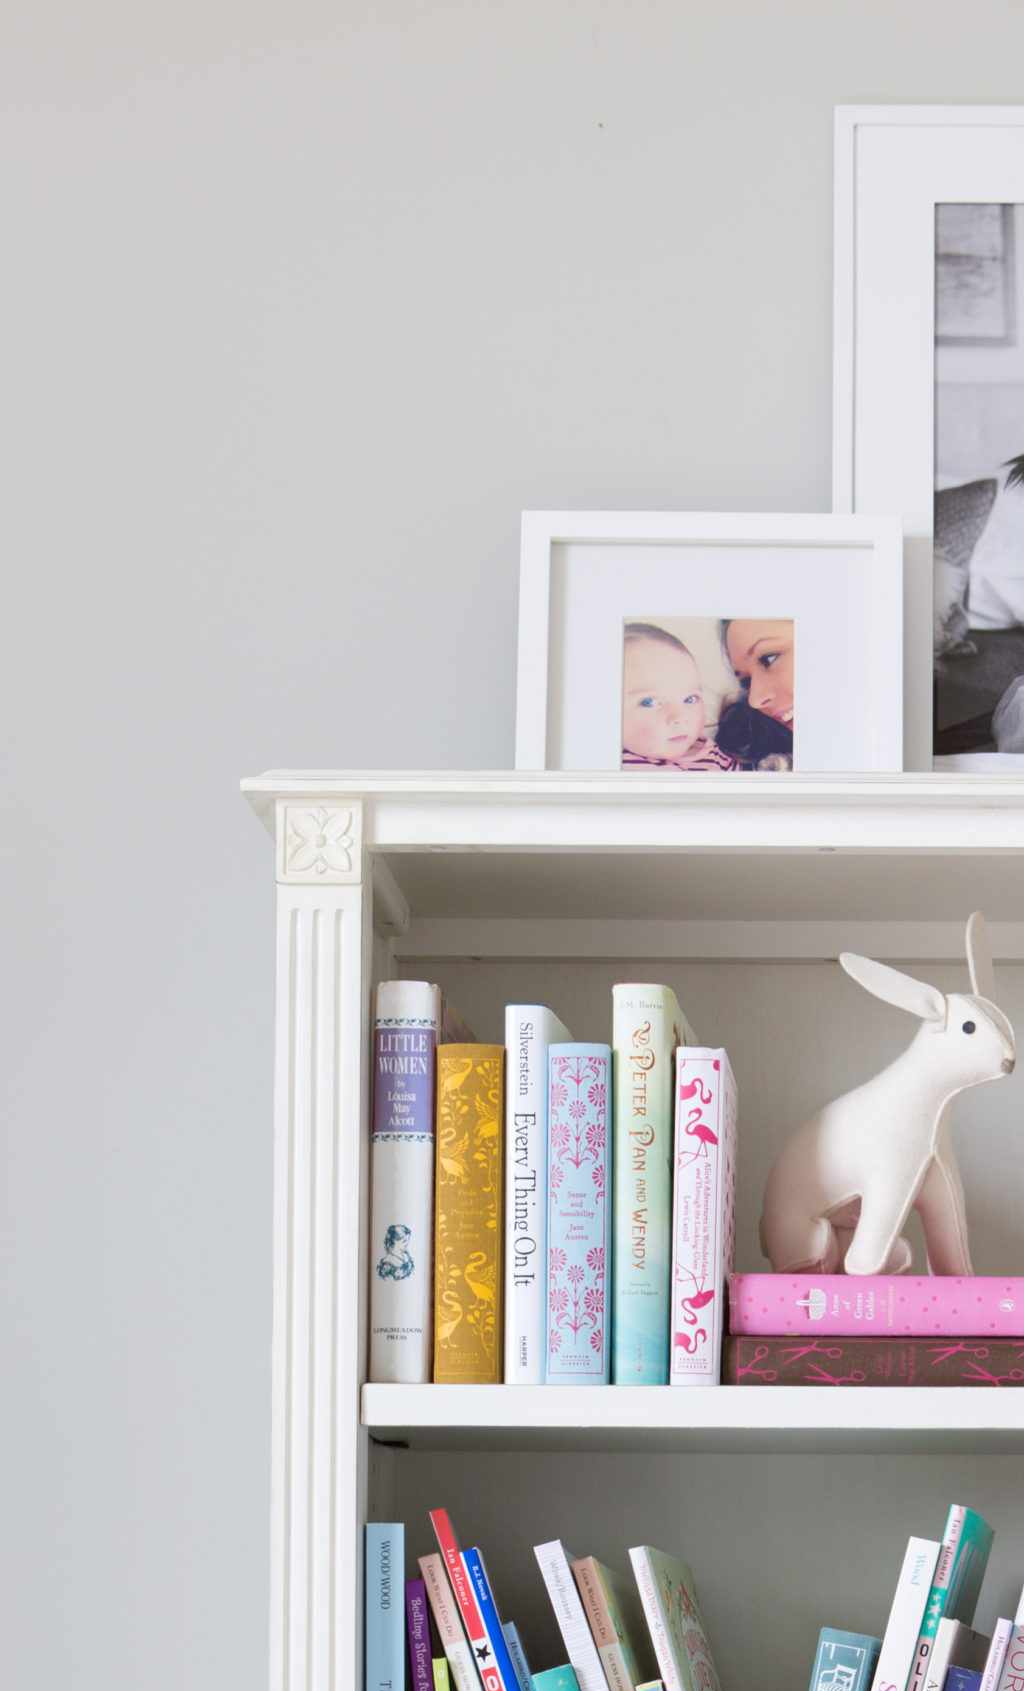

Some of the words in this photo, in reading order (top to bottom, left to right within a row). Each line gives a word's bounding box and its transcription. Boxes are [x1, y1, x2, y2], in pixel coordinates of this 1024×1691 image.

[380, 1033, 427, 1053] LITTLE
[379, 1056, 427, 1075] WOMEN
[519, 1022, 532, 1095] Silverstein
[397, 1080, 405, 1090] by
[628, 1048, 655, 1116] PETER
[387, 1091, 416, 1102] Louisa
[393, 1103, 411, 1115] May
[389, 1115, 415, 1127] Alcott
[514, 1112, 535, 1167] Every
[627, 1123, 654, 1170] PAN
[514, 1170, 535, 1231] Thing
[570, 1200, 584, 1208] and
[635, 1179, 646, 1202] AND
[559, 1210, 595, 1219] Sensibility
[569, 1224, 584, 1232] Jane
[514, 1236, 536, 1266] On
[631, 1208, 647, 1269] WENDY
[514, 1272, 534, 1286] It
[831, 1294, 839, 1318] Anne
[854, 1292, 863, 1320] Green
[866, 1291, 874, 1321] Gables
[446, 1548, 458, 1564] Ian
[909, 1553, 926, 1586] Wood
[380, 1540, 390, 1609] WOOD/WOOD
[451, 1566, 471, 1606] Falconer
[409, 1599, 424, 1640] Bedtime
[414, 1642, 428, 1678] Stories
